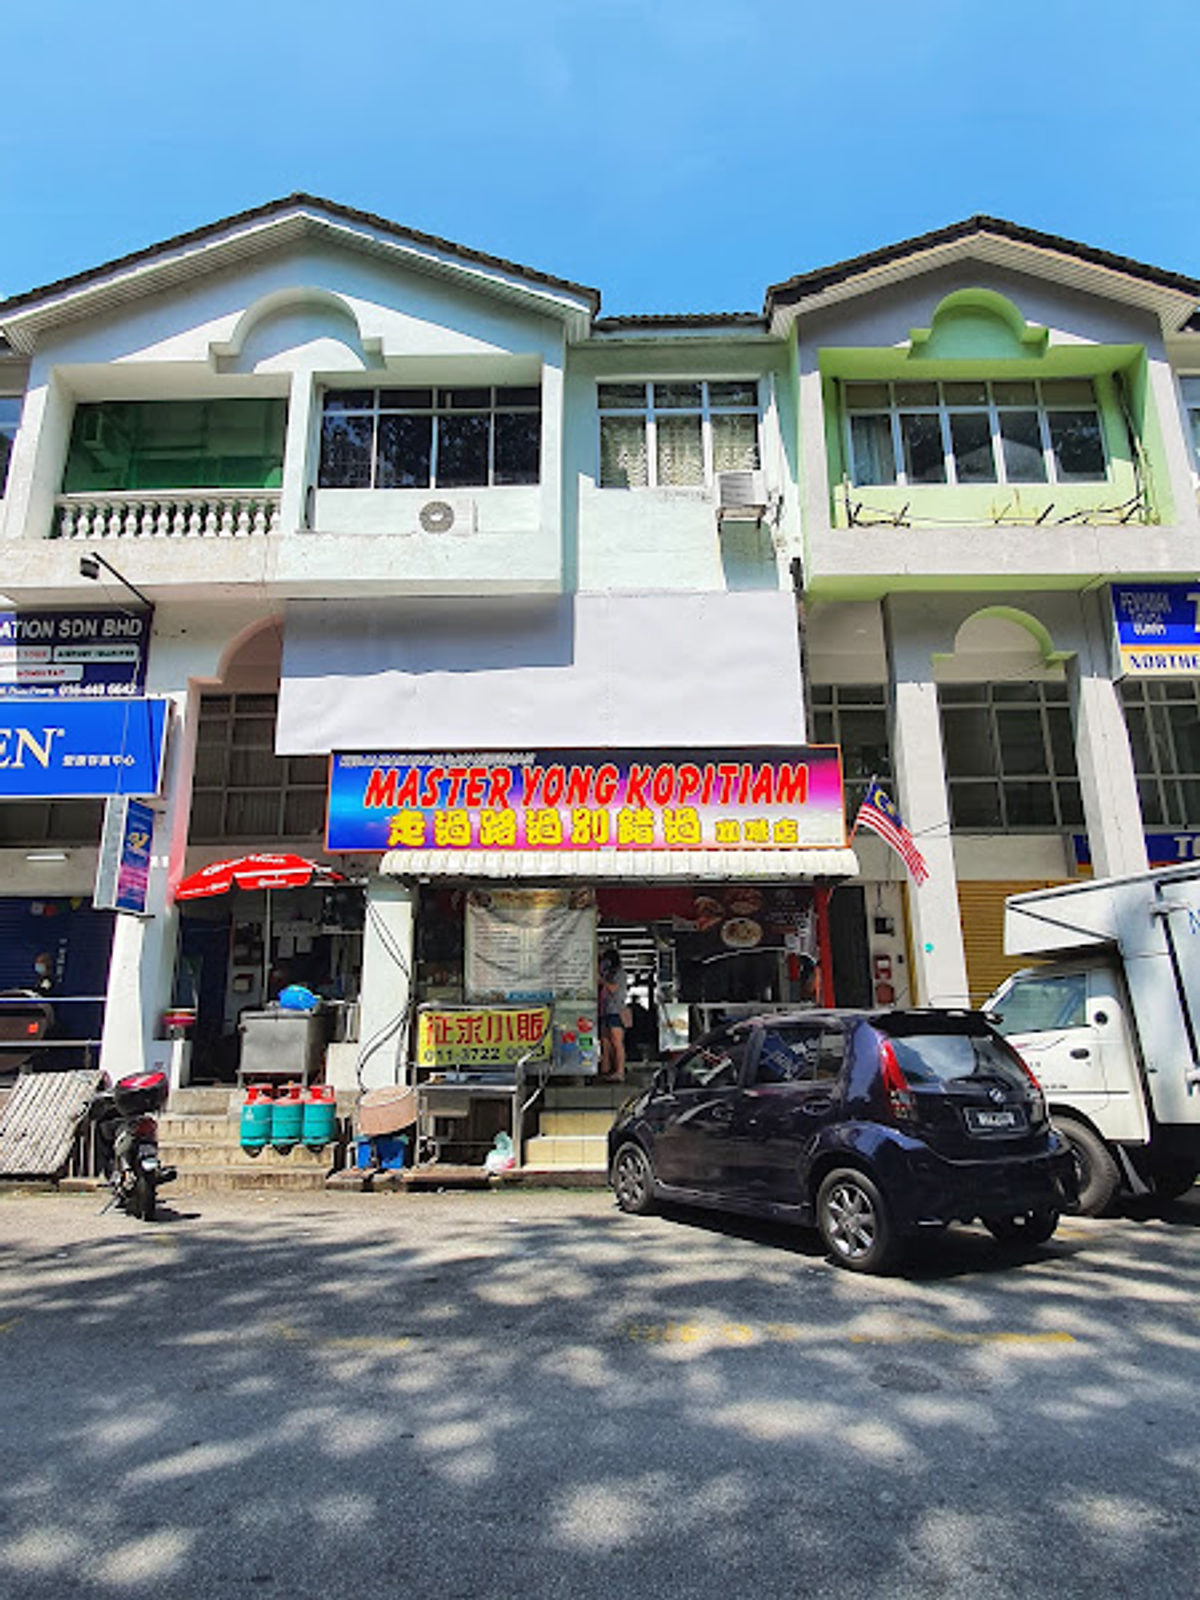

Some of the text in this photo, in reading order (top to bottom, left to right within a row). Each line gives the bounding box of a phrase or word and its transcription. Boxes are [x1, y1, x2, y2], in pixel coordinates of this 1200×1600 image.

[58, 619, 98, 638] SDN
[101, 618, 143, 637] BHD
[364, 762, 809, 809] MASTER YONG KOPITIAM
